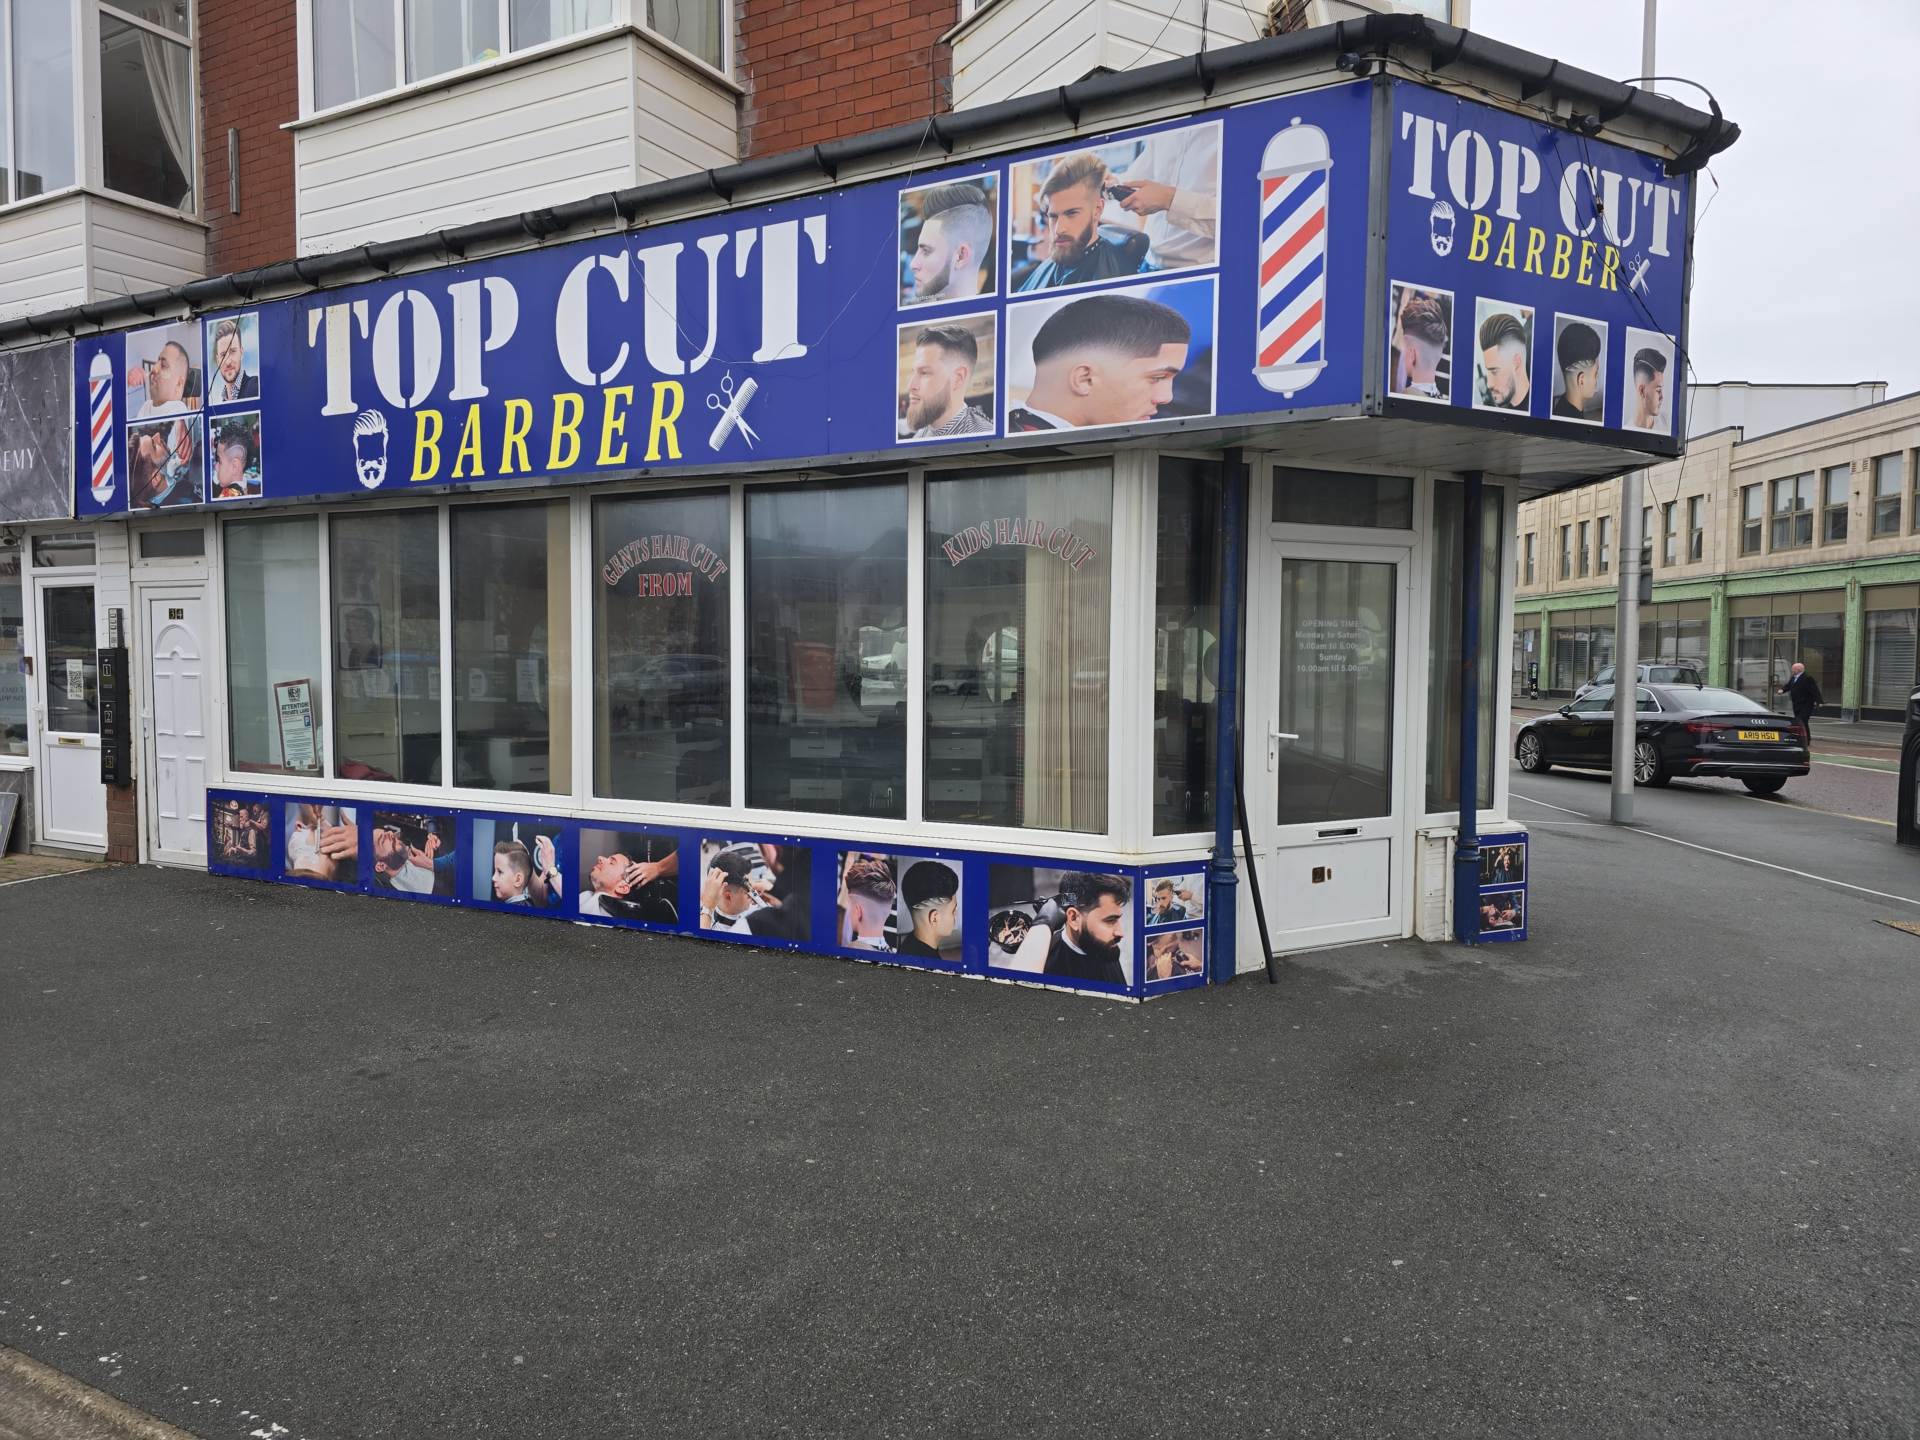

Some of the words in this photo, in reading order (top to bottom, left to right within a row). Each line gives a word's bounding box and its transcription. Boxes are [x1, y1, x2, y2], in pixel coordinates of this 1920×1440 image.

[1401, 110, 1541, 220] TOP
[1559, 160, 1681, 257] CUT
[1467, 213, 1621, 292] BARBER
[308, 276, 519, 417] TOP
[555, 214, 827, 387] CUT
[409, 380, 685, 482] BARBER
[601, 536, 650, 586] GENTS
[650, 534, 690, 562] HAIR
[690, 542, 728, 583] CUT
[942, 520, 993, 567] KIDS
[993, 517, 1046, 549] HAIR
[1047, 526, 1097, 572] CUT
[638, 571, 693, 597] FROM
[169, 608, 183, 620] 34
[1295, 630, 1324, 641] Monday
[1297, 664, 1329, 673] 10.00am
[1319, 652, 1347, 663] Sunday
[1743, 731, 1760, 740] AR19
[1760, 731, 1776, 740] HSU
